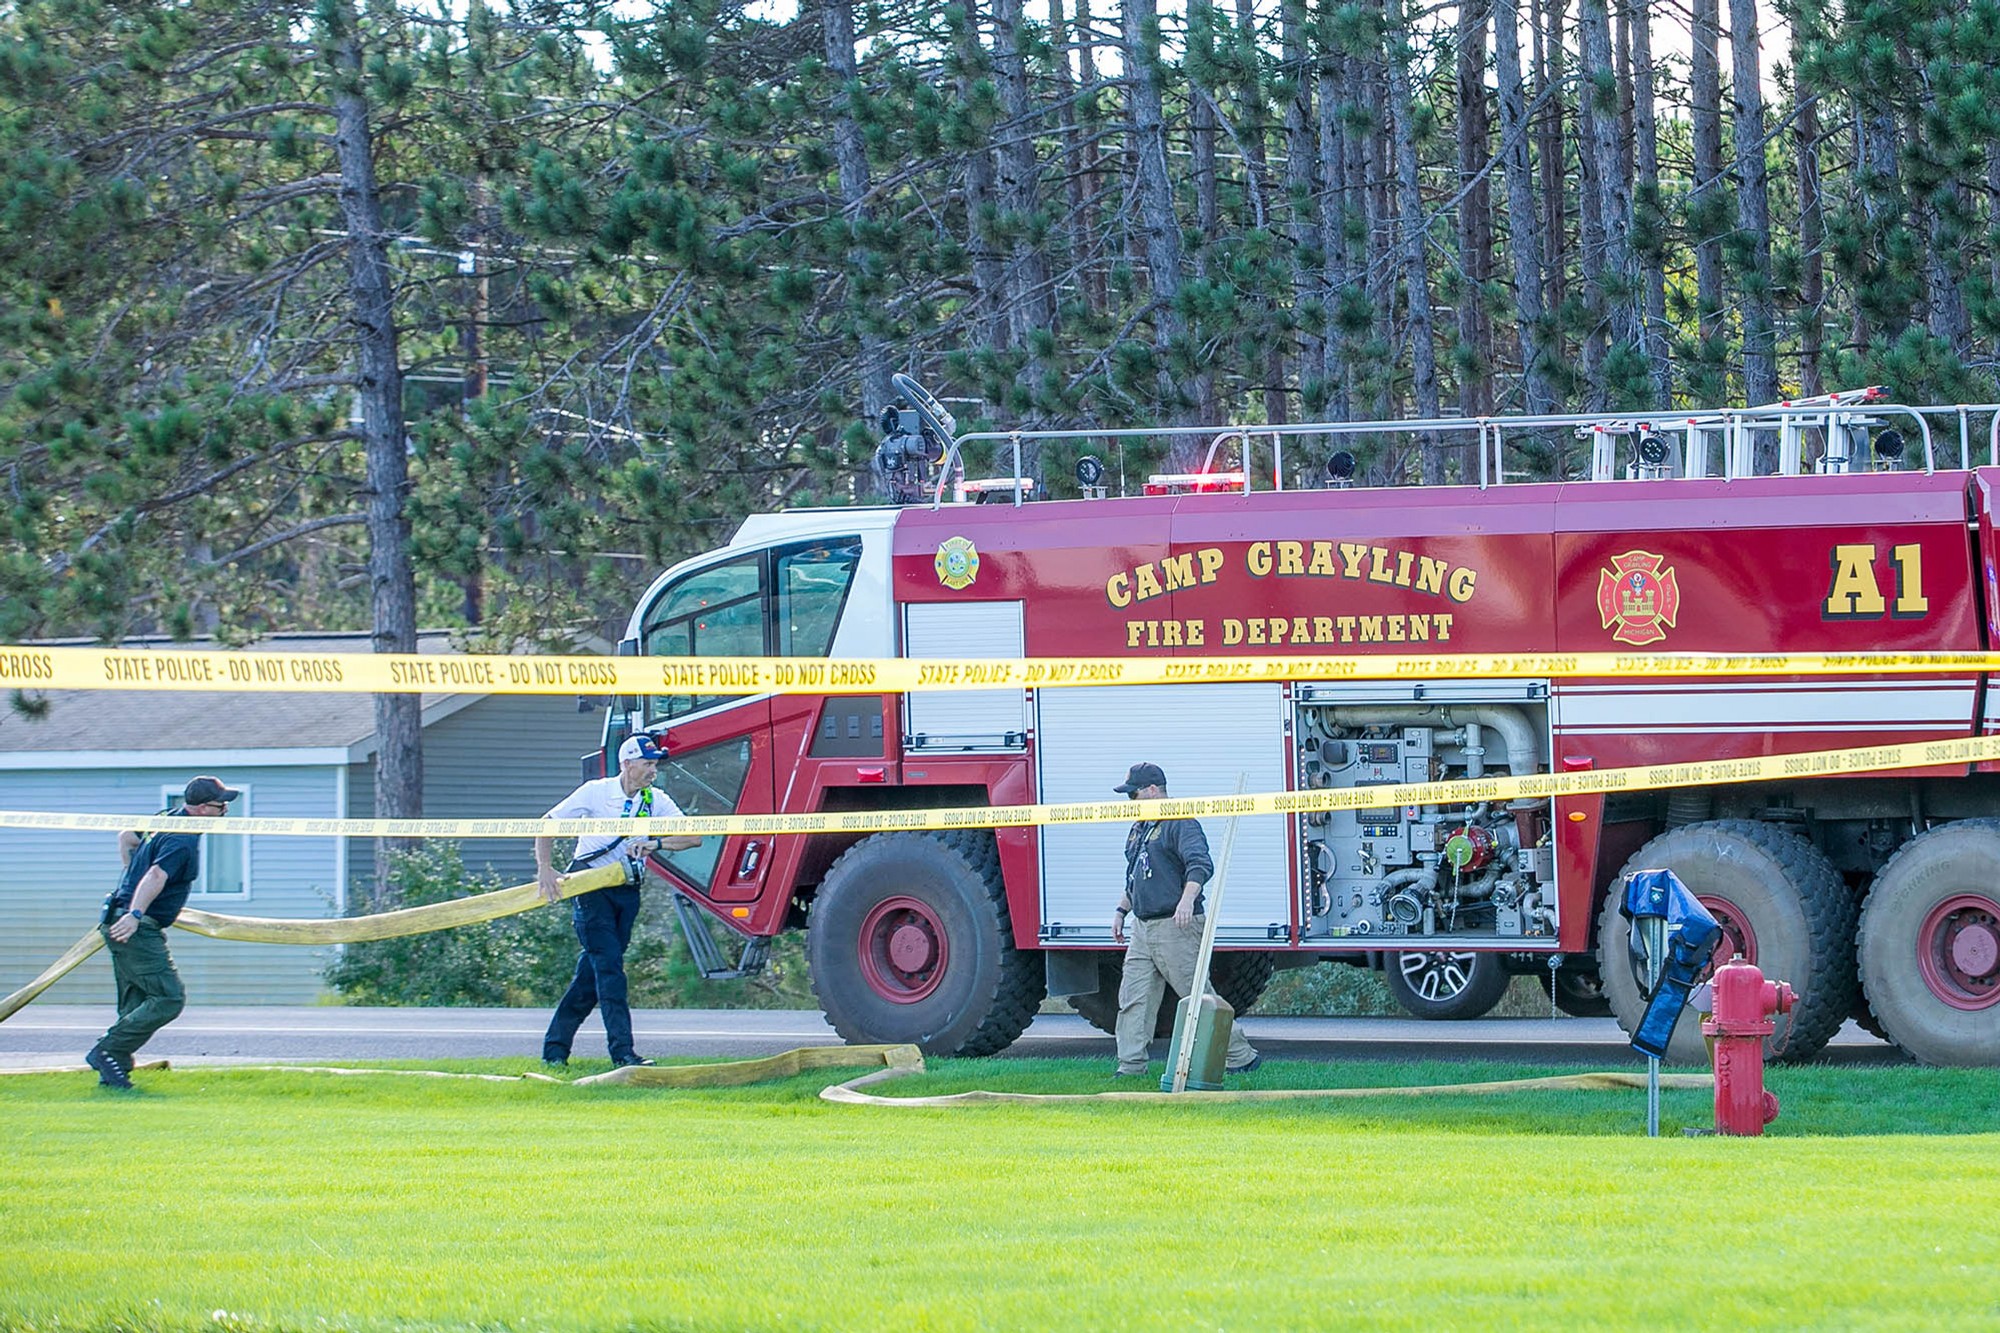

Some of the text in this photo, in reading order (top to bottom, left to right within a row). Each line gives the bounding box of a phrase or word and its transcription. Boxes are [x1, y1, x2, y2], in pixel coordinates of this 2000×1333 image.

[1106, 540, 1478, 608] CAMP GRAYLING
[1823, 543, 1928, 620] A1
[1126, 614, 1454, 648] FIRE DEPARTMENT
[0, 654, 52, 678] CROSS
[104, 657, 150, 680] STATE
[156, 658, 212, 681] POLICE
[231, 660, 250, 682] DO
[257, 660, 285, 682] NOT
[291, 660, 343, 682] CROSS
[390, 662, 436, 684] STATE
[440, 662, 494, 684] POLICE
[510, 663, 530, 684] DO
[535, 663, 562, 684] NOT
[568, 663, 618, 684] CROSS
[662, 664, 704, 686] STATE
[710, 664, 759, 686] POLICE
[776, 664, 794, 685] DO
[798, 664, 824, 686] NOT
[830, 664, 876, 684] CROSS
[918, 665, 958, 684] STATE
[964, 665, 1012, 684] POLICE
[1025, 664, 1045, 682] DO
[1049, 664, 1076, 682] NOT
[1077, 664, 1123, 680] CROSS
[1676, 768, 1689, 782] NOT
[1692, 767, 1702, 780] DO
[1711, 764, 1736, 779] POLICE
[1740, 762, 1760, 776] STATE
[1578, 775, 1602, 789] POLICE
[1606, 772, 1626, 787] STATE
[1650, 769, 1673, 784] CROSS
[1477, 782, 1497, 796] STATE
[1520, 779, 1542, 793] CROSS
[1545, 778, 1557, 792] NOT
[1560, 777, 1570, 790] DO
[1354, 790, 1373, 804] STATE
[1395, 788, 1416, 802] CROSS
[1419, 788, 1431, 800] NOT
[1434, 786, 1443, 799] DO
[1451, 784, 1474, 798] POLICE
[1236, 798, 1254, 811] STATE
[1275, 797, 1296, 810] CROSS
[1298, 796, 1310, 808] NOT
[1312, 794, 1321, 807] DO
[1329, 793, 1351, 806] POLICE
[1085, 807, 1093, 819] DO
[1100, 806, 1120, 818] POLICE
[1123, 804, 1141, 817] STATE
[1160, 803, 1180, 816] CROSS
[1182, 802, 1194, 814] NOT
[1196, 801, 1205, 814] DO
[1212, 800, 1234, 813] POLICE
[944, 813, 963, 825] CROSS
[965, 812, 976, 824] NOT
[978, 811, 985, 824] DO
[992, 810, 1012, 823] POLICE
[1014, 809, 1031, 822] STATE
[1050, 808, 1070, 821] CROSS
[1071, 807, 1083, 820] NOT
